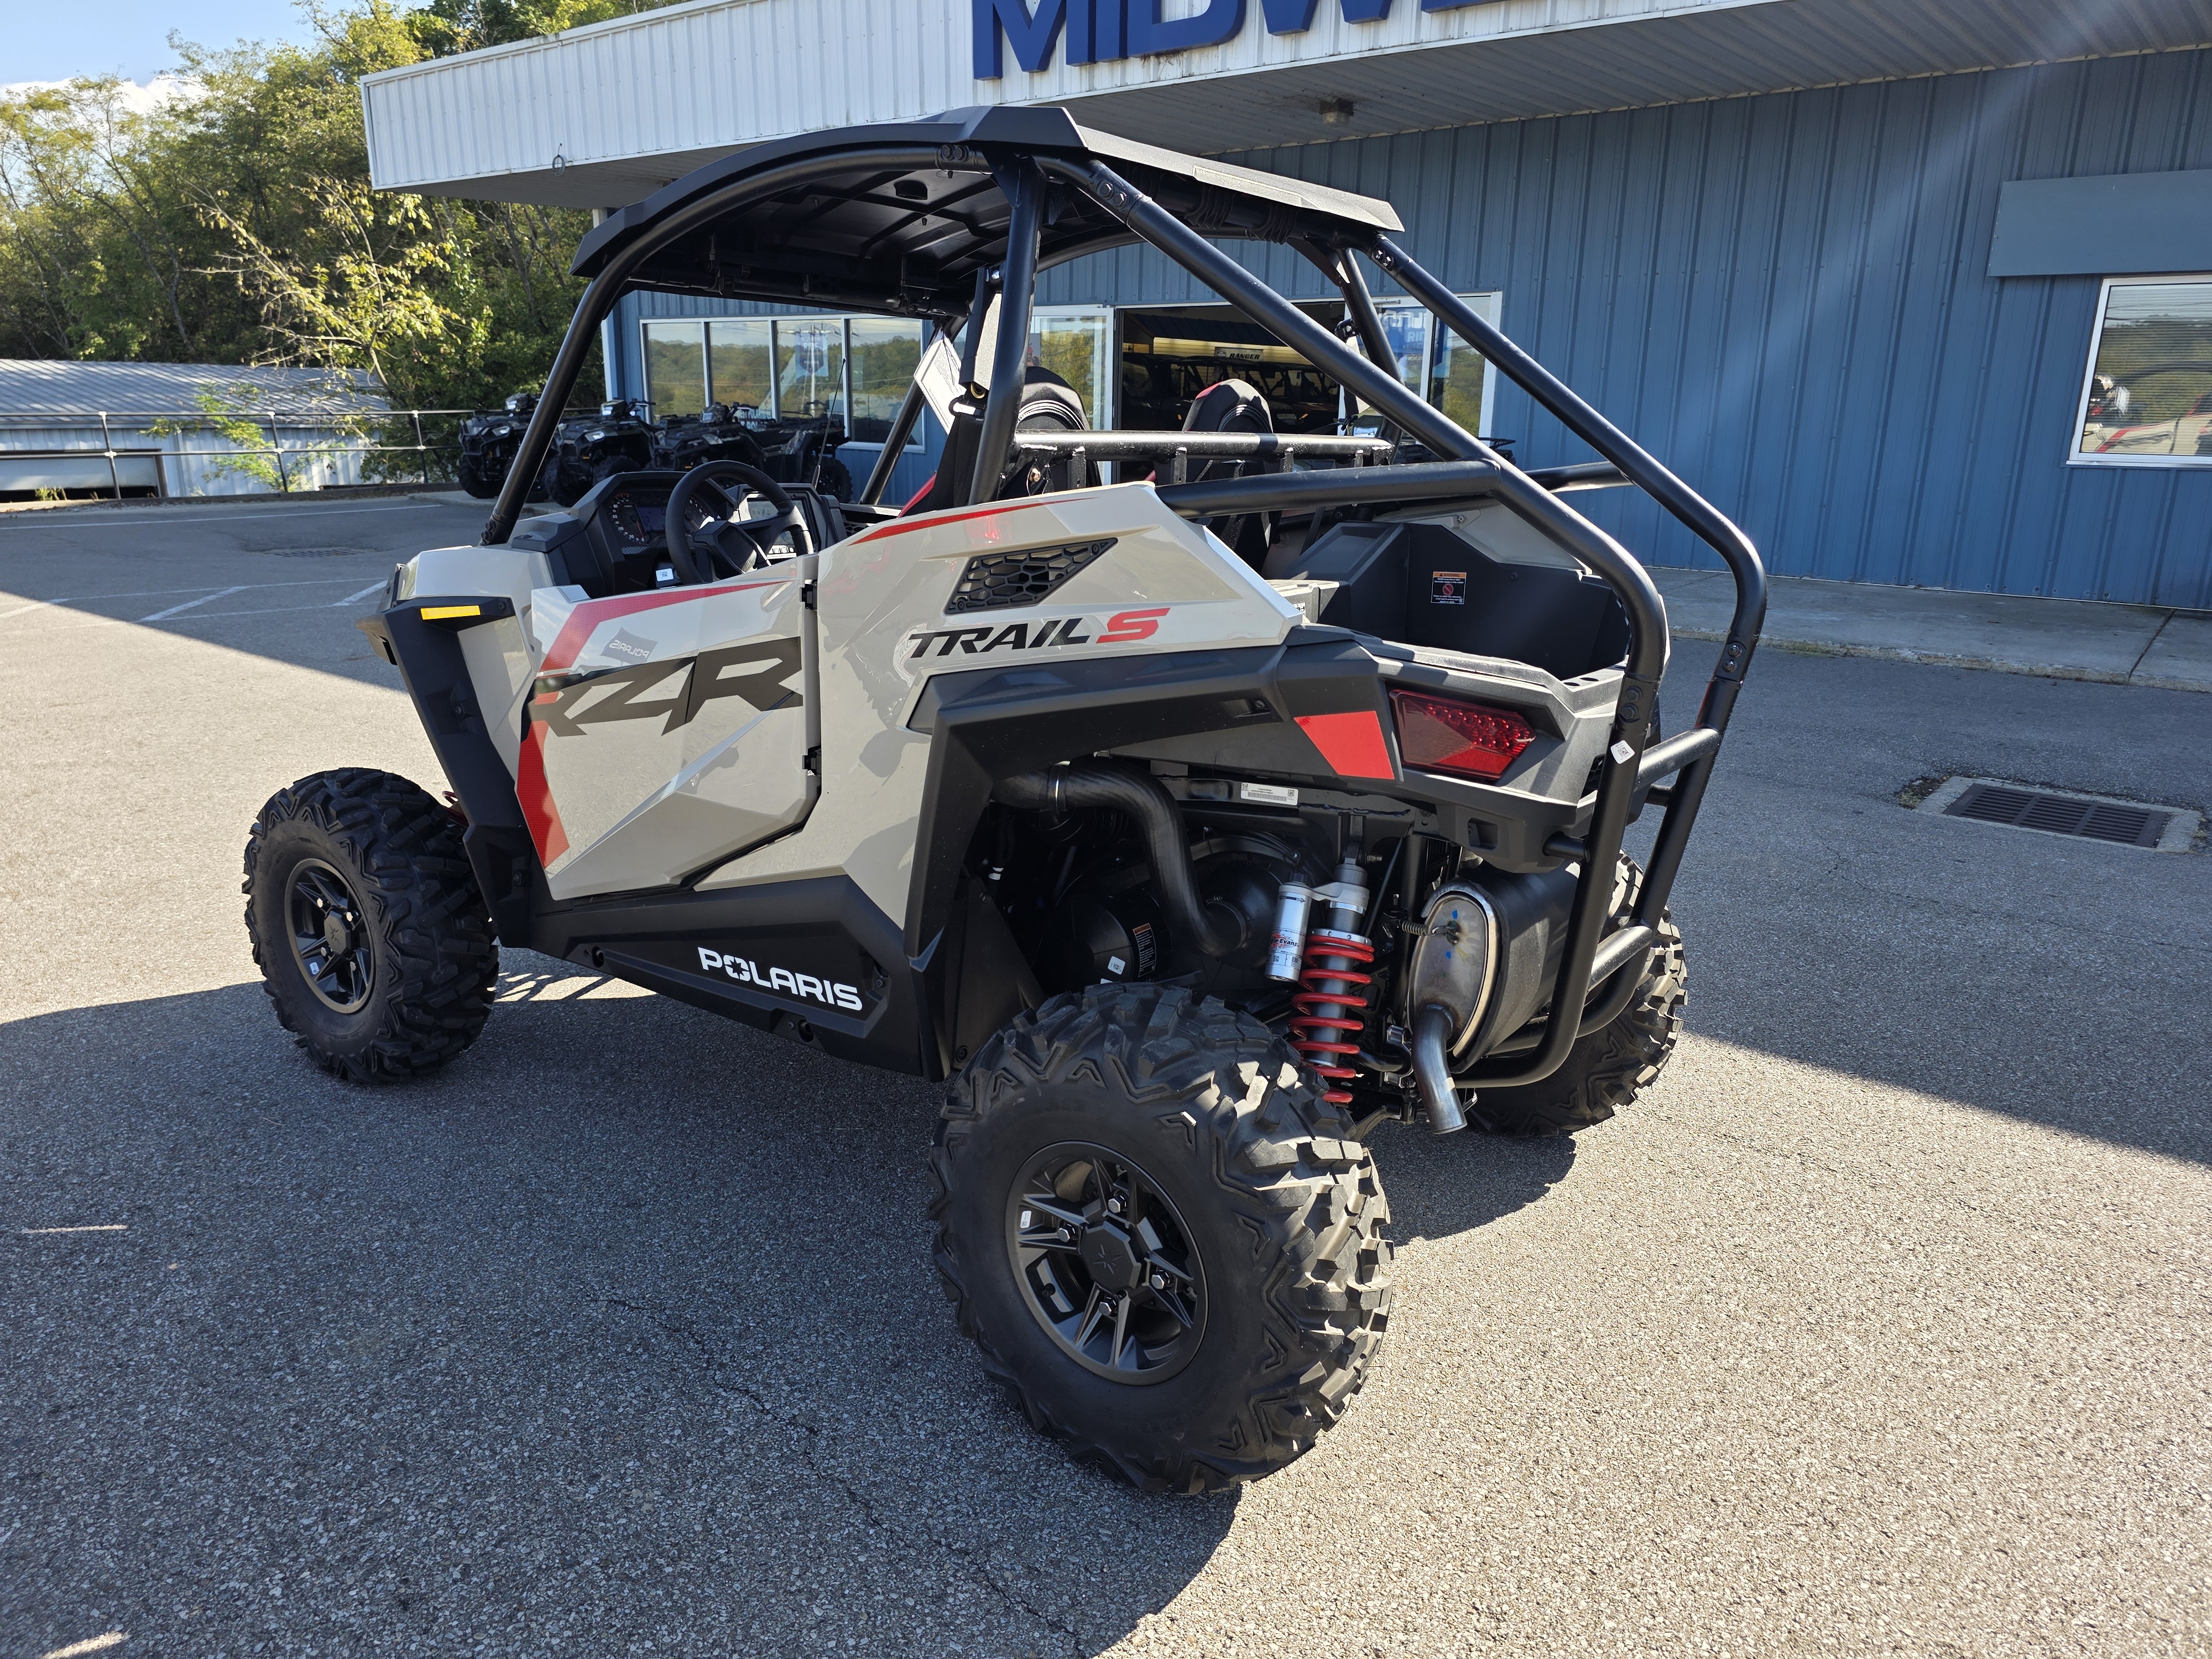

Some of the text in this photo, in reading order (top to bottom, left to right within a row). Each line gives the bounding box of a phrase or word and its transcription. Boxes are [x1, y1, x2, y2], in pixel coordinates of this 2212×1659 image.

[909, 607, 1171, 659] TRAIL S
[697, 947, 863, 1011] POLARIS
